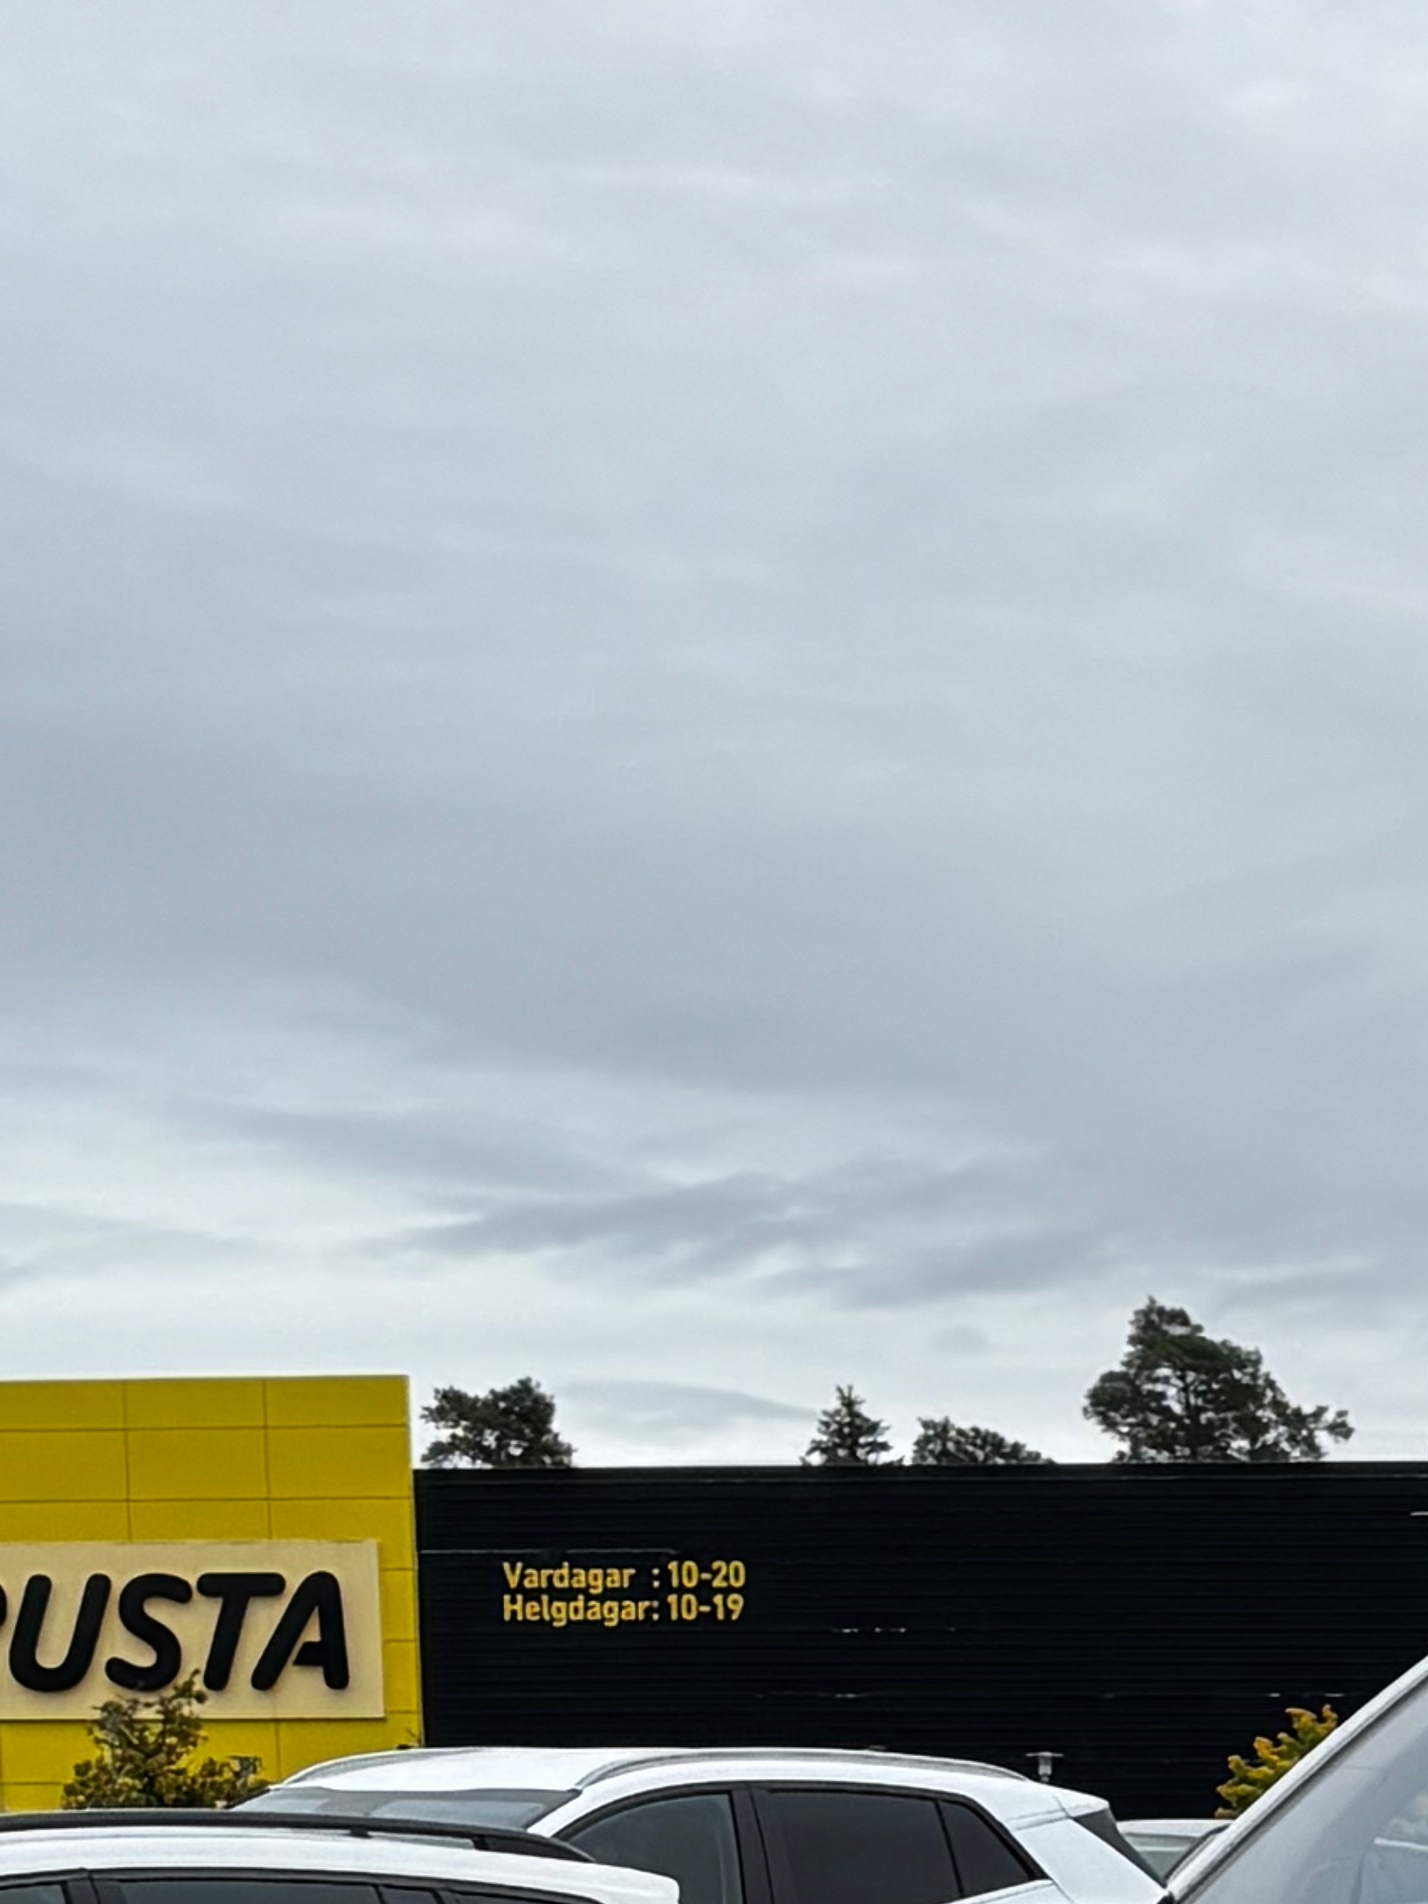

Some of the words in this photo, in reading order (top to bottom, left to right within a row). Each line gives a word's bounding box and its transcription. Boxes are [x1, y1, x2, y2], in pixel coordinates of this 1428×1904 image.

[502, 1561, 636, 1594] Vardagar
[667, 1560, 746, 1589] 10-20
[667, 1593, 744, 1621] 10-19
[0, 1571, 350, 1692] USTA
